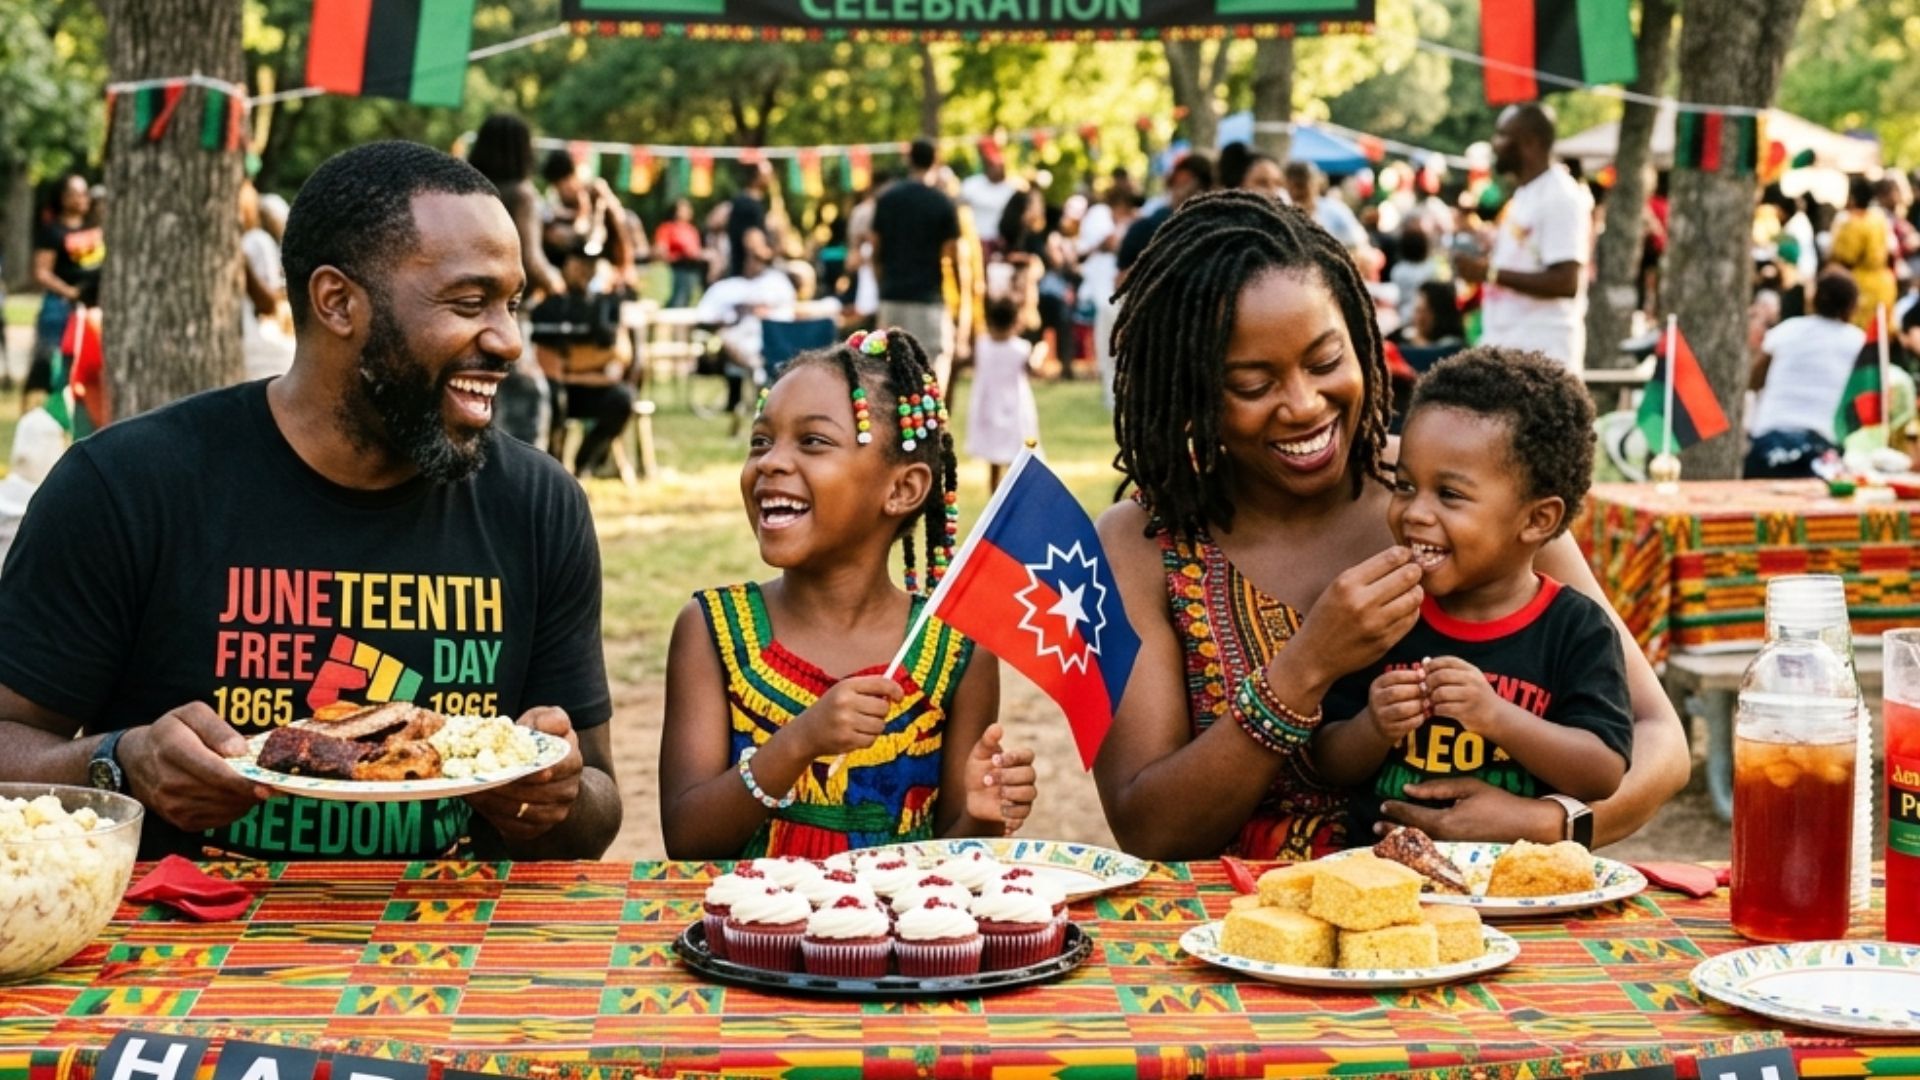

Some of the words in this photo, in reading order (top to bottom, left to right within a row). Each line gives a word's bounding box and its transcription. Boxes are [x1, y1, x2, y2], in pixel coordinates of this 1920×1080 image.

[800, 0, 1142, 21] CELEBRATION
[218, 567, 503, 632] JUNETEENTH
[215, 631, 316, 681] FREE
[433, 638, 502, 684] DAY
[213, 686, 293, 727] 1865
[1404, 724, 1485, 773] LEO
[204, 796, 421, 856] REEDOM
